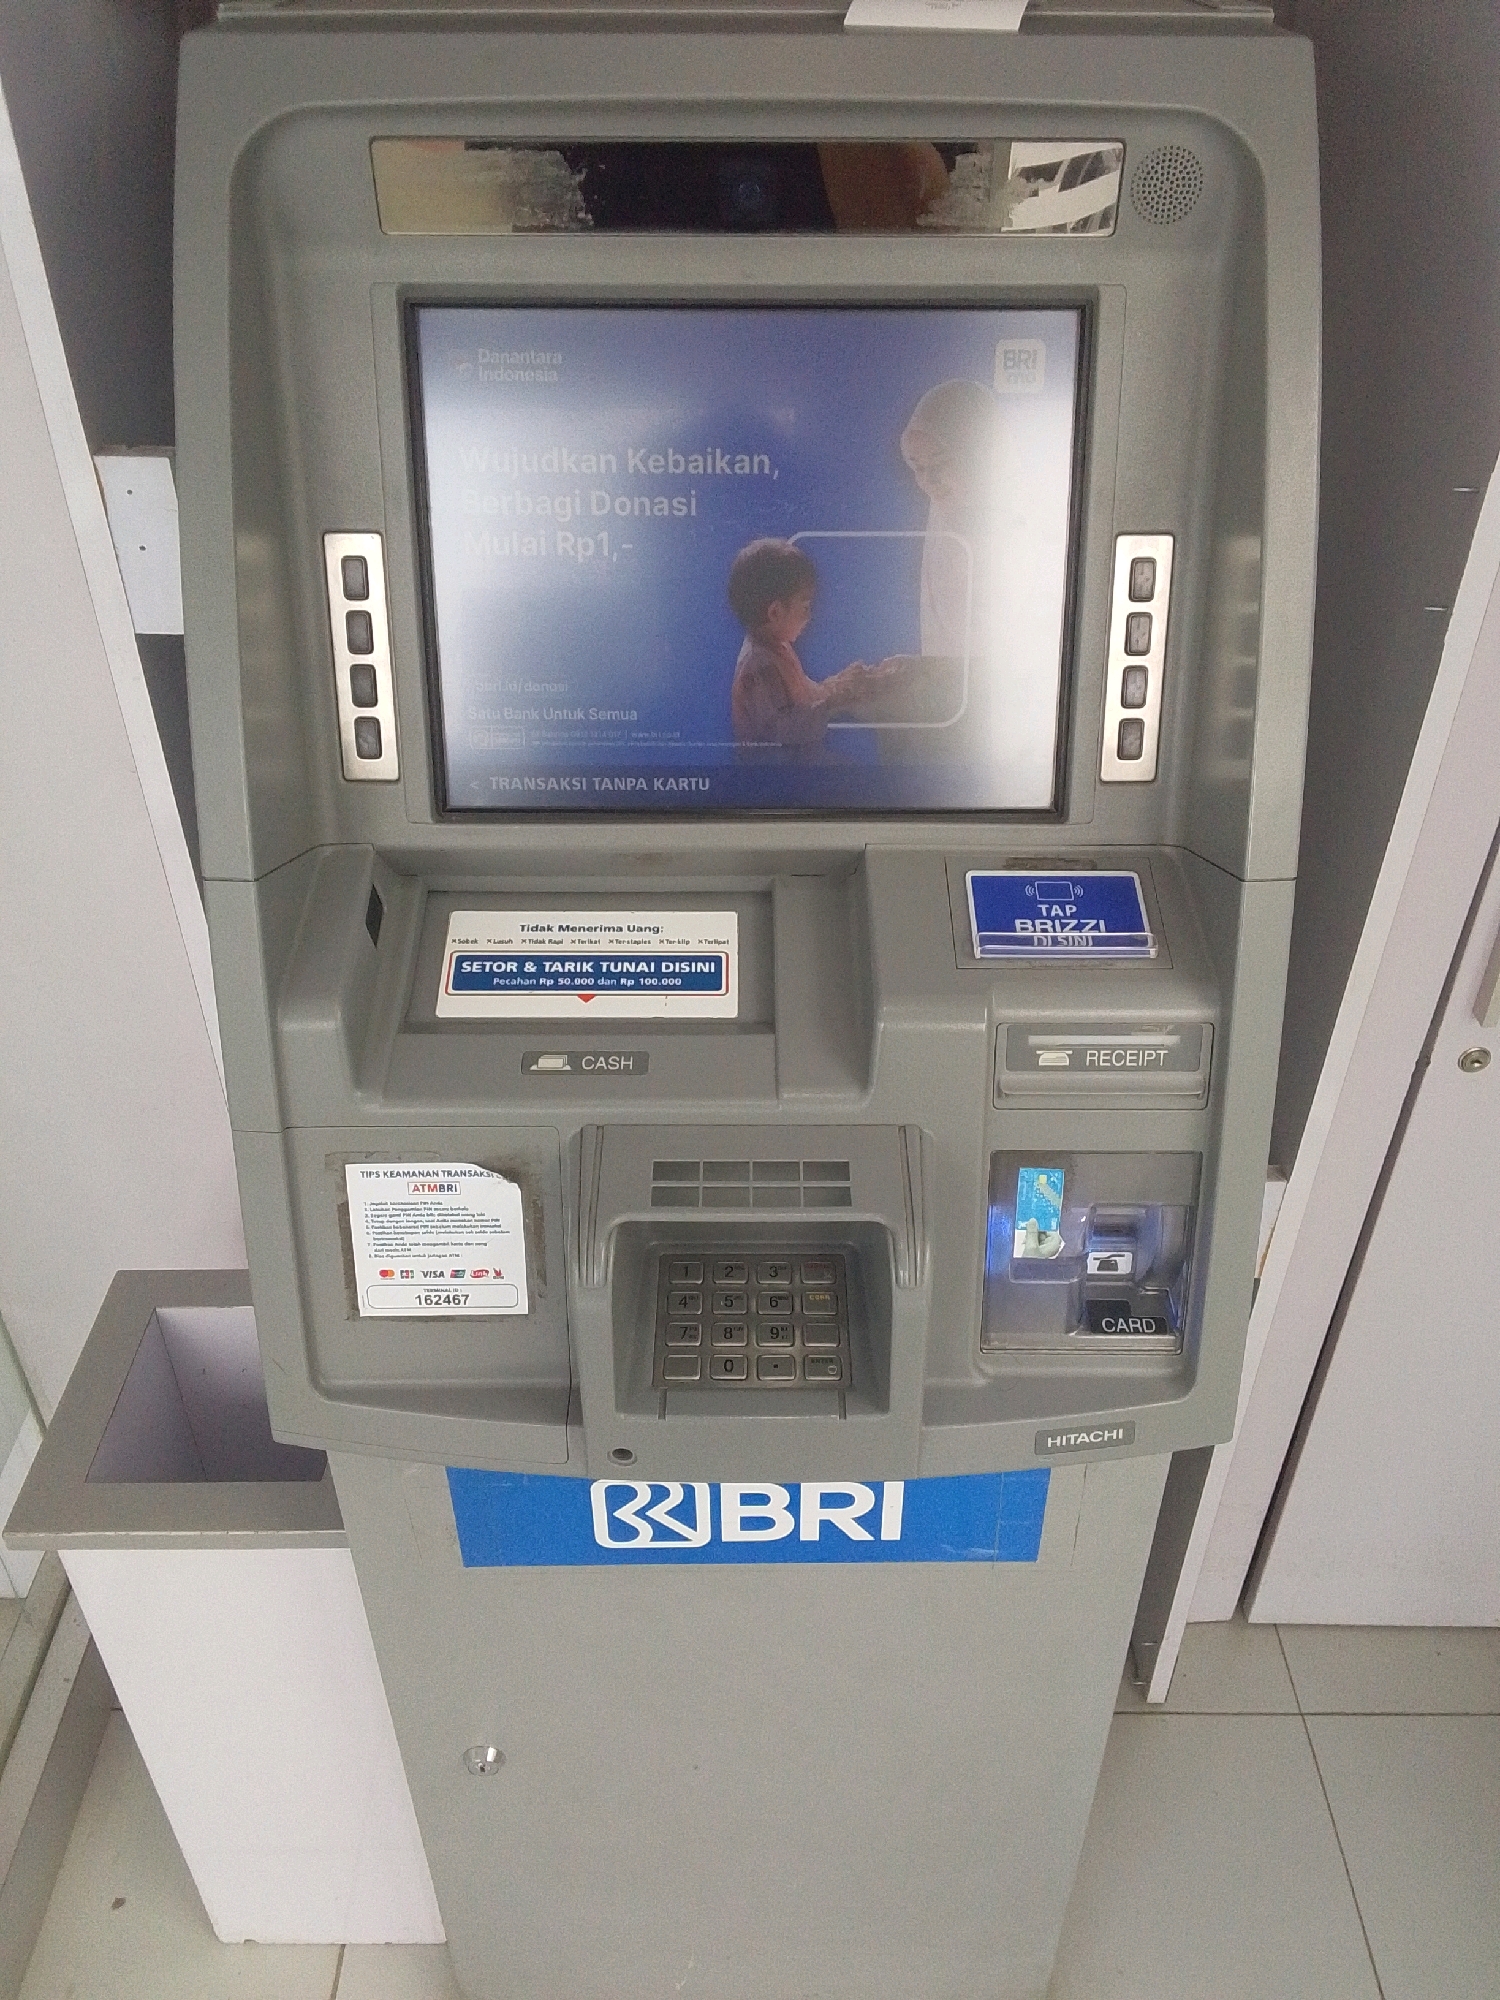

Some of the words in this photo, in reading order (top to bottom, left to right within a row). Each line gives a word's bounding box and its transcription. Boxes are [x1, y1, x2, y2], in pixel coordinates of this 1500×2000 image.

[477, 348, 563, 365] Danantara
[1002, 349, 1038, 370] BRI
[477, 366, 559, 382] Indonesia
[460, 448, 618, 479] Wujudkan
[627, 448, 779, 480] Kebaikan,
[590, 490, 697, 517] Donasi
[556, 531, 634, 562] Rp1,-
[504, 706, 539, 721] Bank
[543, 707, 585, 721] Untuk
[589, 707, 638, 721] Semua
[489, 777, 587, 791] TRANSAKSI
[594, 777, 648, 791] TANPA
[653, 777, 710, 791] KARTU
[1037, 904, 1077, 917] TAP
[519, 924, 554, 933] Tidak
[557, 924, 623, 933] Menerima
[627, 924, 664, 934] Uang:
[1014, 919, 1106, 933] BRIZZI
[460, 961, 518, 973] SETOR
[523, 961, 538, 973] &
[542, 961, 595, 973] TARIK
[599, 961, 655, 973] TUNAI
[661, 961, 715, 973] DISINI
[493, 977, 537, 986] Pecahan
[539, 977, 555, 987] Rp
[557, 977, 594, 986] 50.000
[597, 977, 617, 986] dan
[620, 977, 635, 987] Rp
[638, 977, 682, 986] 100.000
[581, 1055, 634, 1071] CASH
[1085, 1050, 1169, 1067] RECEIPT
[360, 1170, 380, 1179] TIPS
[383, 1170, 439, 1178] KEAMANAN
[411, 1183, 458, 1193] ATMBRI
[420, 1270, 445, 1279] VISA
[684, 1266, 689, 1277] 1
[724, 1266, 734, 1278] 2
[769, 1266, 778, 1278] 3
[414, 1294, 470, 1306] 162467
[678, 1296, 688, 1308] 4
[724, 1295, 734, 1307] 5
[769, 1296, 778, 1307] 6
[1101, 1318, 1156, 1333] CARD
[679, 1326, 688, 1339] 7
[723, 1326, 733, 1339] 8
[770, 1326, 779, 1340] 9
[723, 1359, 734, 1372] 0
[1047, 1428, 1124, 1448] HITACHI
[720, 1481, 905, 1542] BRI
